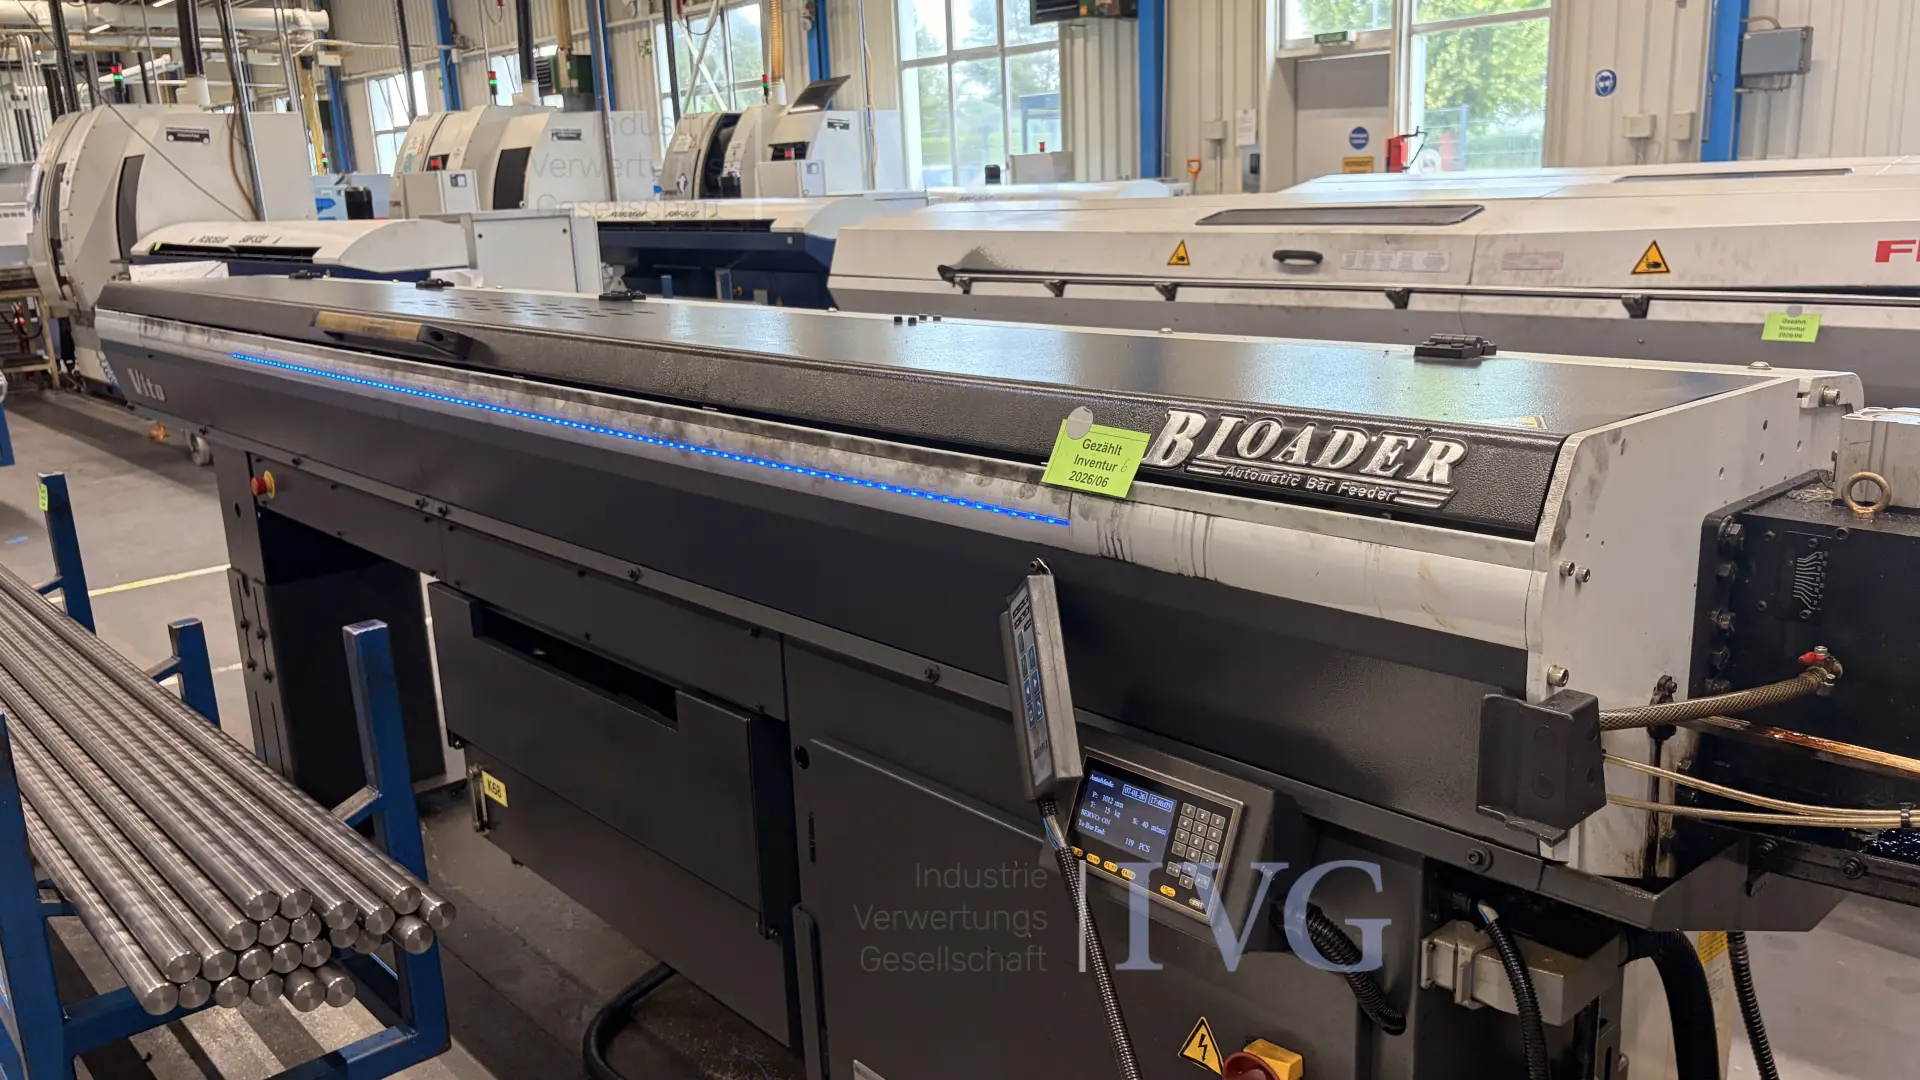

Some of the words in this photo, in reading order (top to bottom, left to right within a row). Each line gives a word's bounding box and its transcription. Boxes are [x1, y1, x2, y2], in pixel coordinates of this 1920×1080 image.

[1875, 240, 1920, 262] F
[127, 367, 167, 402] Vito
[1082, 438, 1123, 456] Gezählt
[1073, 453, 1118, 473] Inventur
[1068, 470, 1110, 488] 2026/06
[1224, 465, 1300, 487] Automatic
[1305, 477, 1335, 492] Bar
[1338, 481, 1397, 502] Feeder
[1138, 842, 1151, 853] PCS
